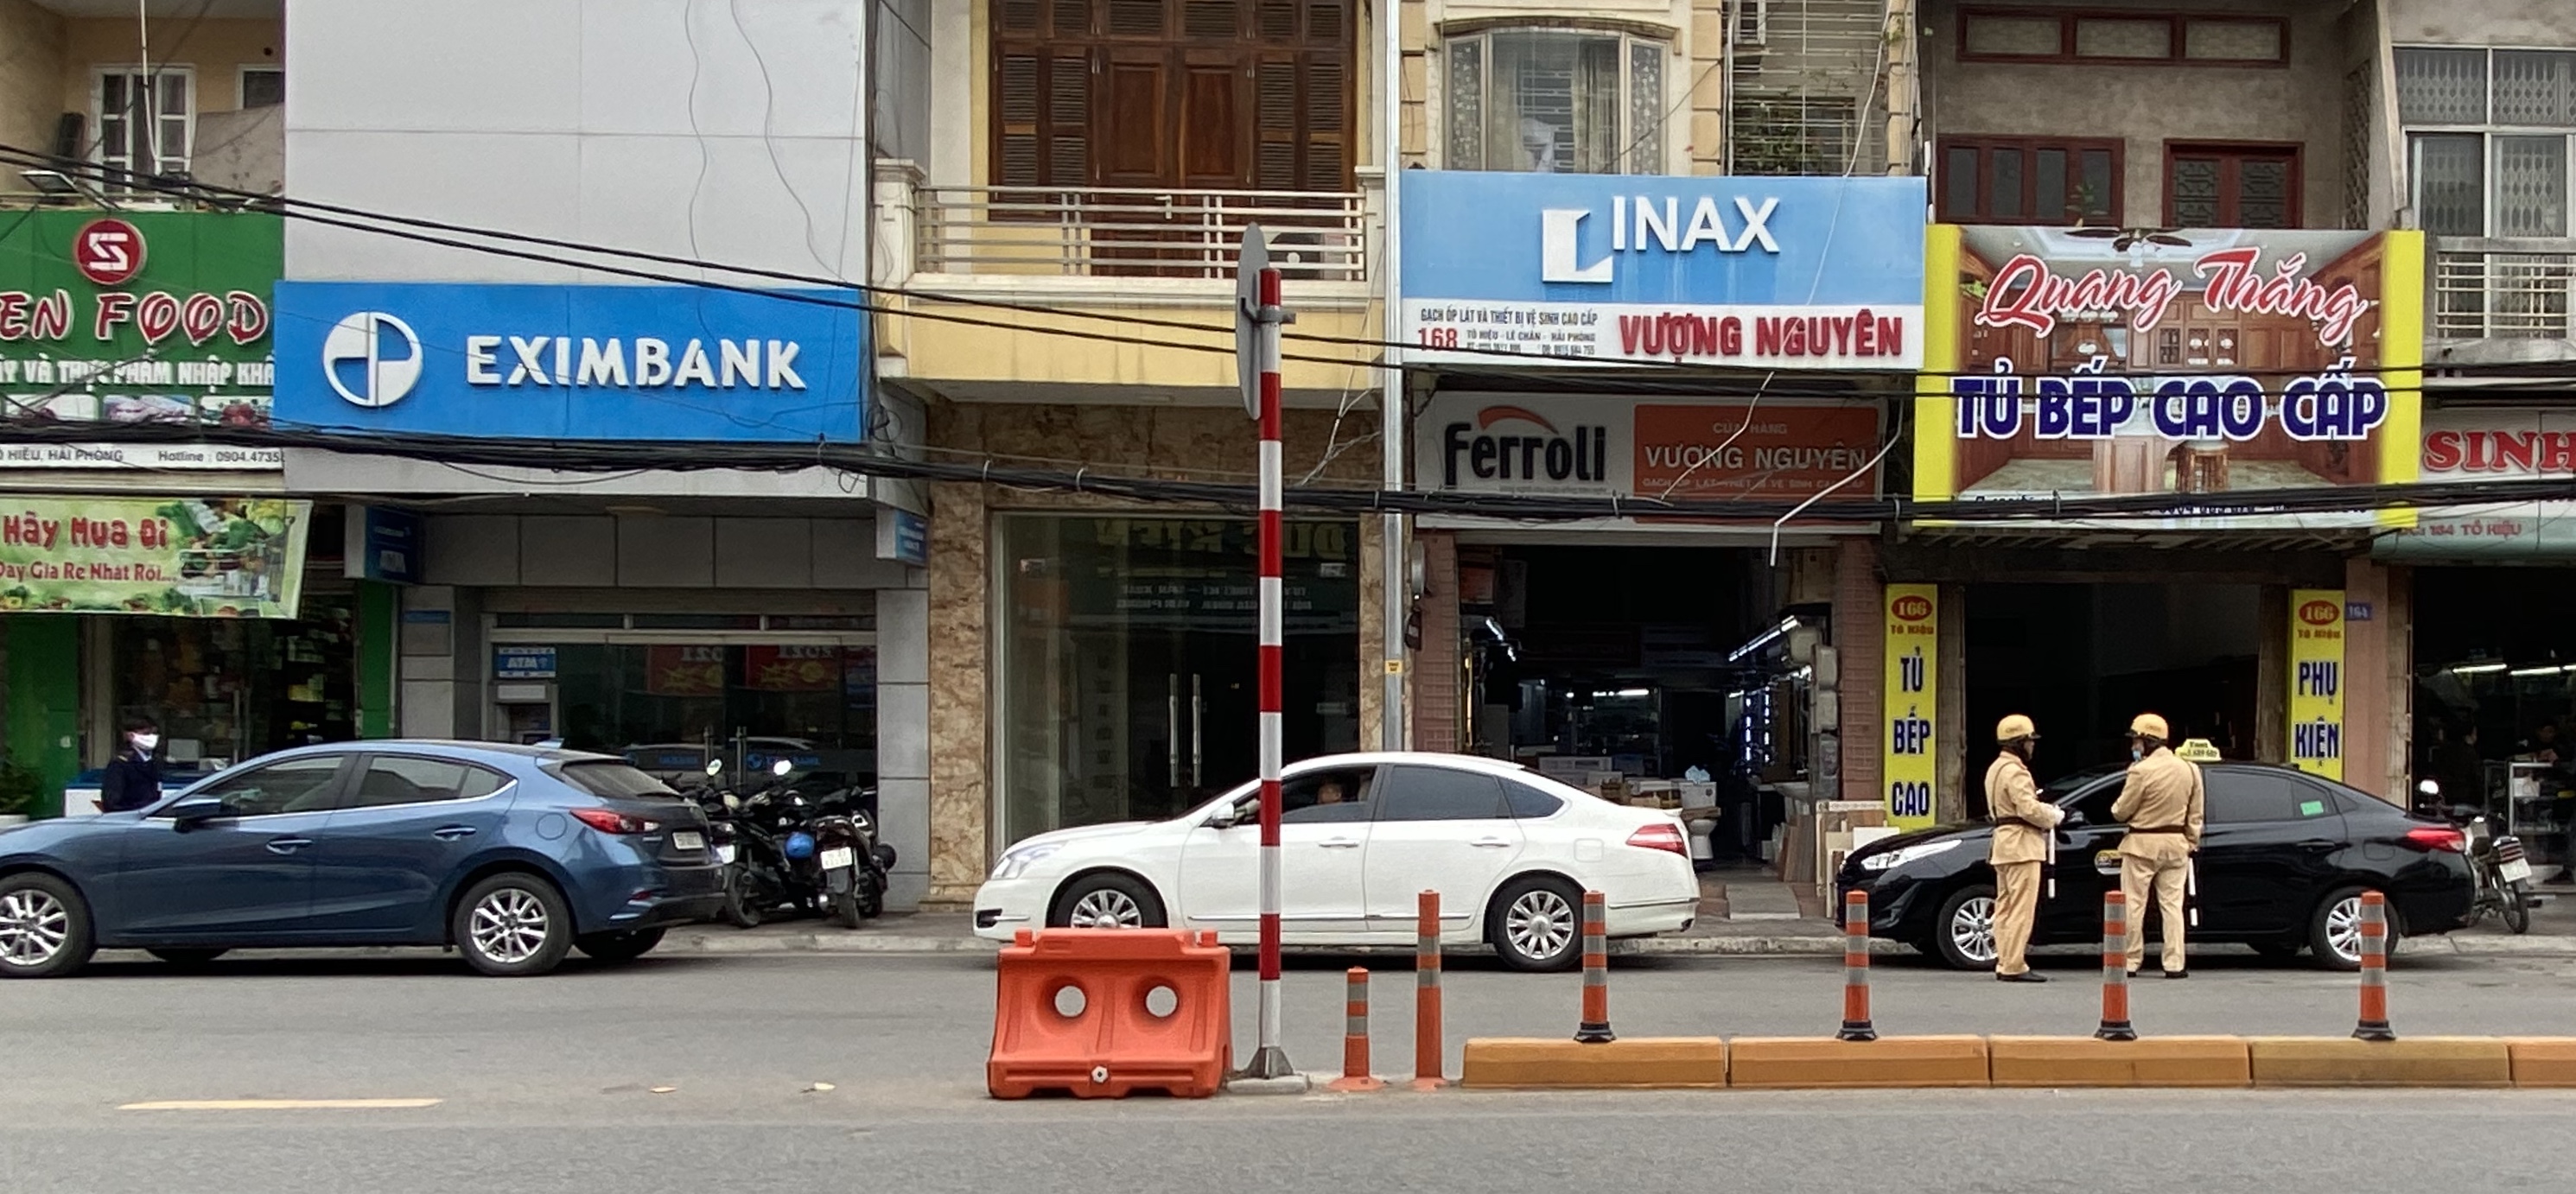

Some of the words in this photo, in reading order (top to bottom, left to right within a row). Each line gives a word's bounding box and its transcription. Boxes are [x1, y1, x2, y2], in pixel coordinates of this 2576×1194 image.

[1612, 194, 1780, 253] INAX
[95, 289, 269, 346] FOOD
[1562, 312, 1578, 326] CAO
[1975, 252, 2183, 339] Quang
[2192, 247, 2369, 347] Thắng
[1418, 327, 1458, 351] 168
[1755, 308, 1903, 357] NGUYÊN
[467, 335, 807, 390] EXIMBANK
[1950, 356, 2023, 440] TỦ
[2035, 355, 2136, 440] BẾP
[2150, 376, 2267, 441] CAO
[2280, 355, 2388, 441] CẤP
[1754, 440, 1867, 471] NGUYÊN
[2423, 429, 2576, 473] SINH
[3, 511, 60, 551] Hãy
[70, 516, 129, 549] Mua
[1900, 645, 1924, 692] TỦ
[2298, 661, 2338, 705] PHỤ
[1892, 704, 1931, 754] BẾP
[2294, 715, 2339, 767] KIỆN
[1891, 781, 1930, 816] CAO
